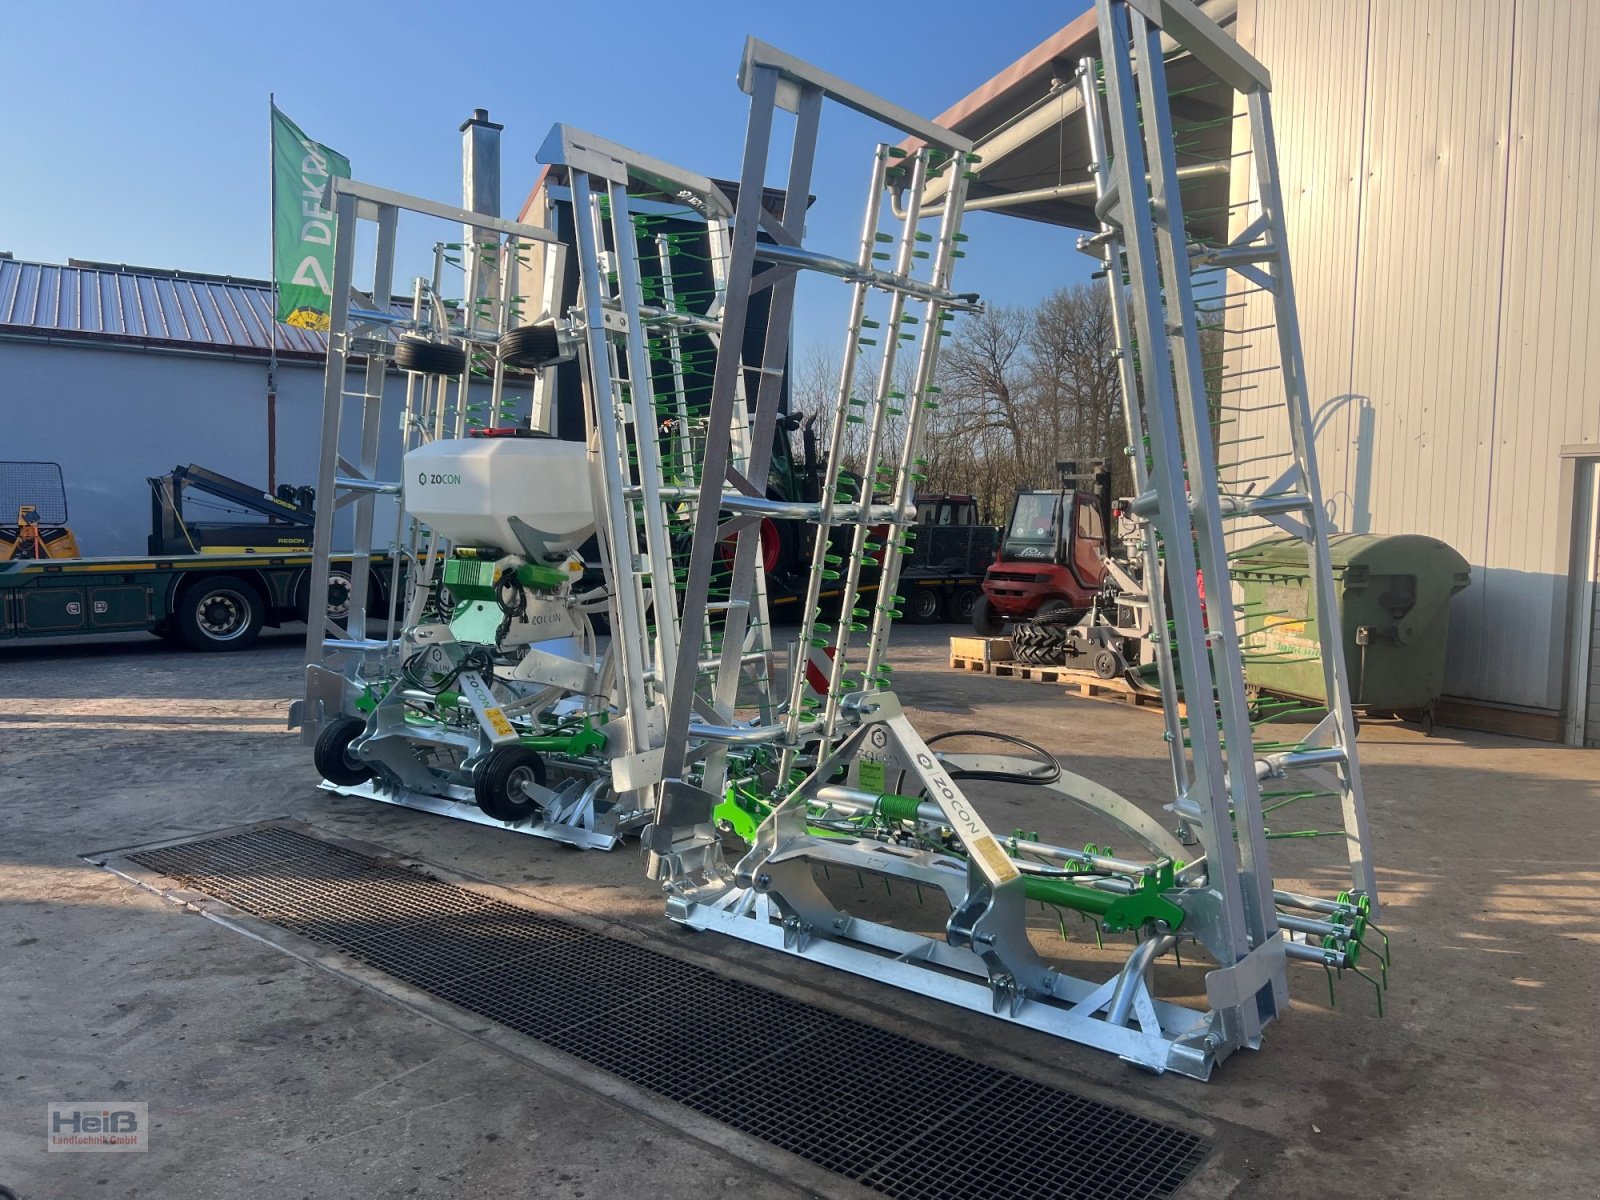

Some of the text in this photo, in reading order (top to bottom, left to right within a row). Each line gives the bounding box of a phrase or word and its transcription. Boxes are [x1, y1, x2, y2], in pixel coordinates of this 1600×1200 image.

[430, 474, 461, 485] ZOCON
[464, 674, 492, 709] ZOCON
[933, 778, 980, 834] ZOCON
